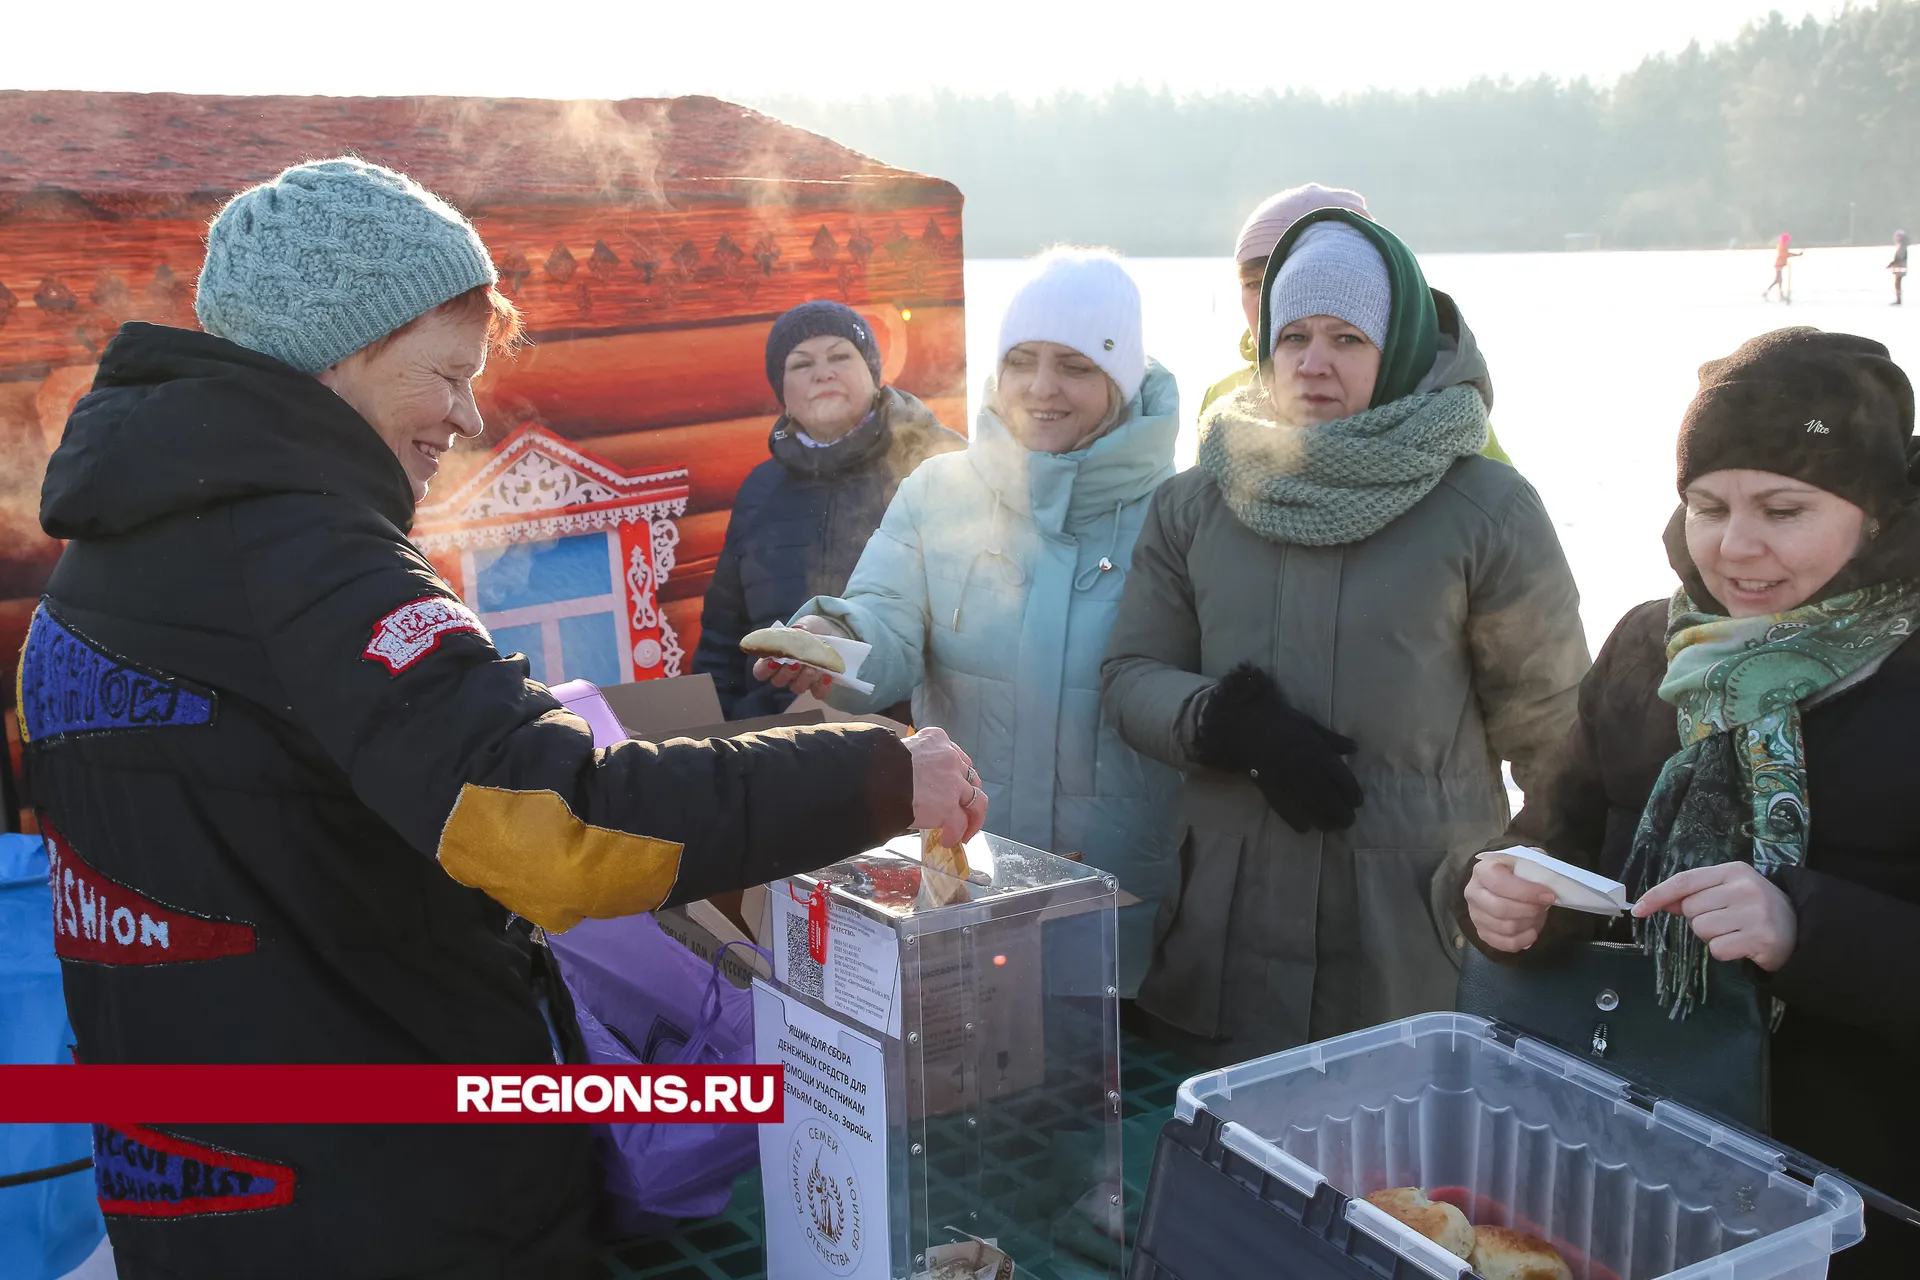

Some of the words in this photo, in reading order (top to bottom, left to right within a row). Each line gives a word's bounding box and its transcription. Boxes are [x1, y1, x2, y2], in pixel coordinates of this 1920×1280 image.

[1804, 419, 1830, 435] Nice
[777, 1038, 818, 1069] ДЕНЕЖНЫХ
[818, 1060, 849, 1086] СРЕДСТВ
[850, 1079, 867, 1095] ДЛЯ
[788, 1024, 810, 1043] ЯЩИК
[811, 1036, 827, 1053] ДЛЯ
[827, 1044, 852, 1067] СБОРА
[781, 1059, 815, 1087] ПОМОЩИ
[815, 1080, 866, 1117] УЧАСТНИКАМ
[808, 1127, 839, 1155] СЕМЕЙ
[813, 1098, 828, 1115] СВО
[842, 1115, 873, 1143] Зарайск.
[792, 1139, 804, 1215] КОМИТЕТ
[846, 1176, 860, 1251] ВОИНОВ
[806, 1226, 851, 1267] ОТЕЧЕСТВА
